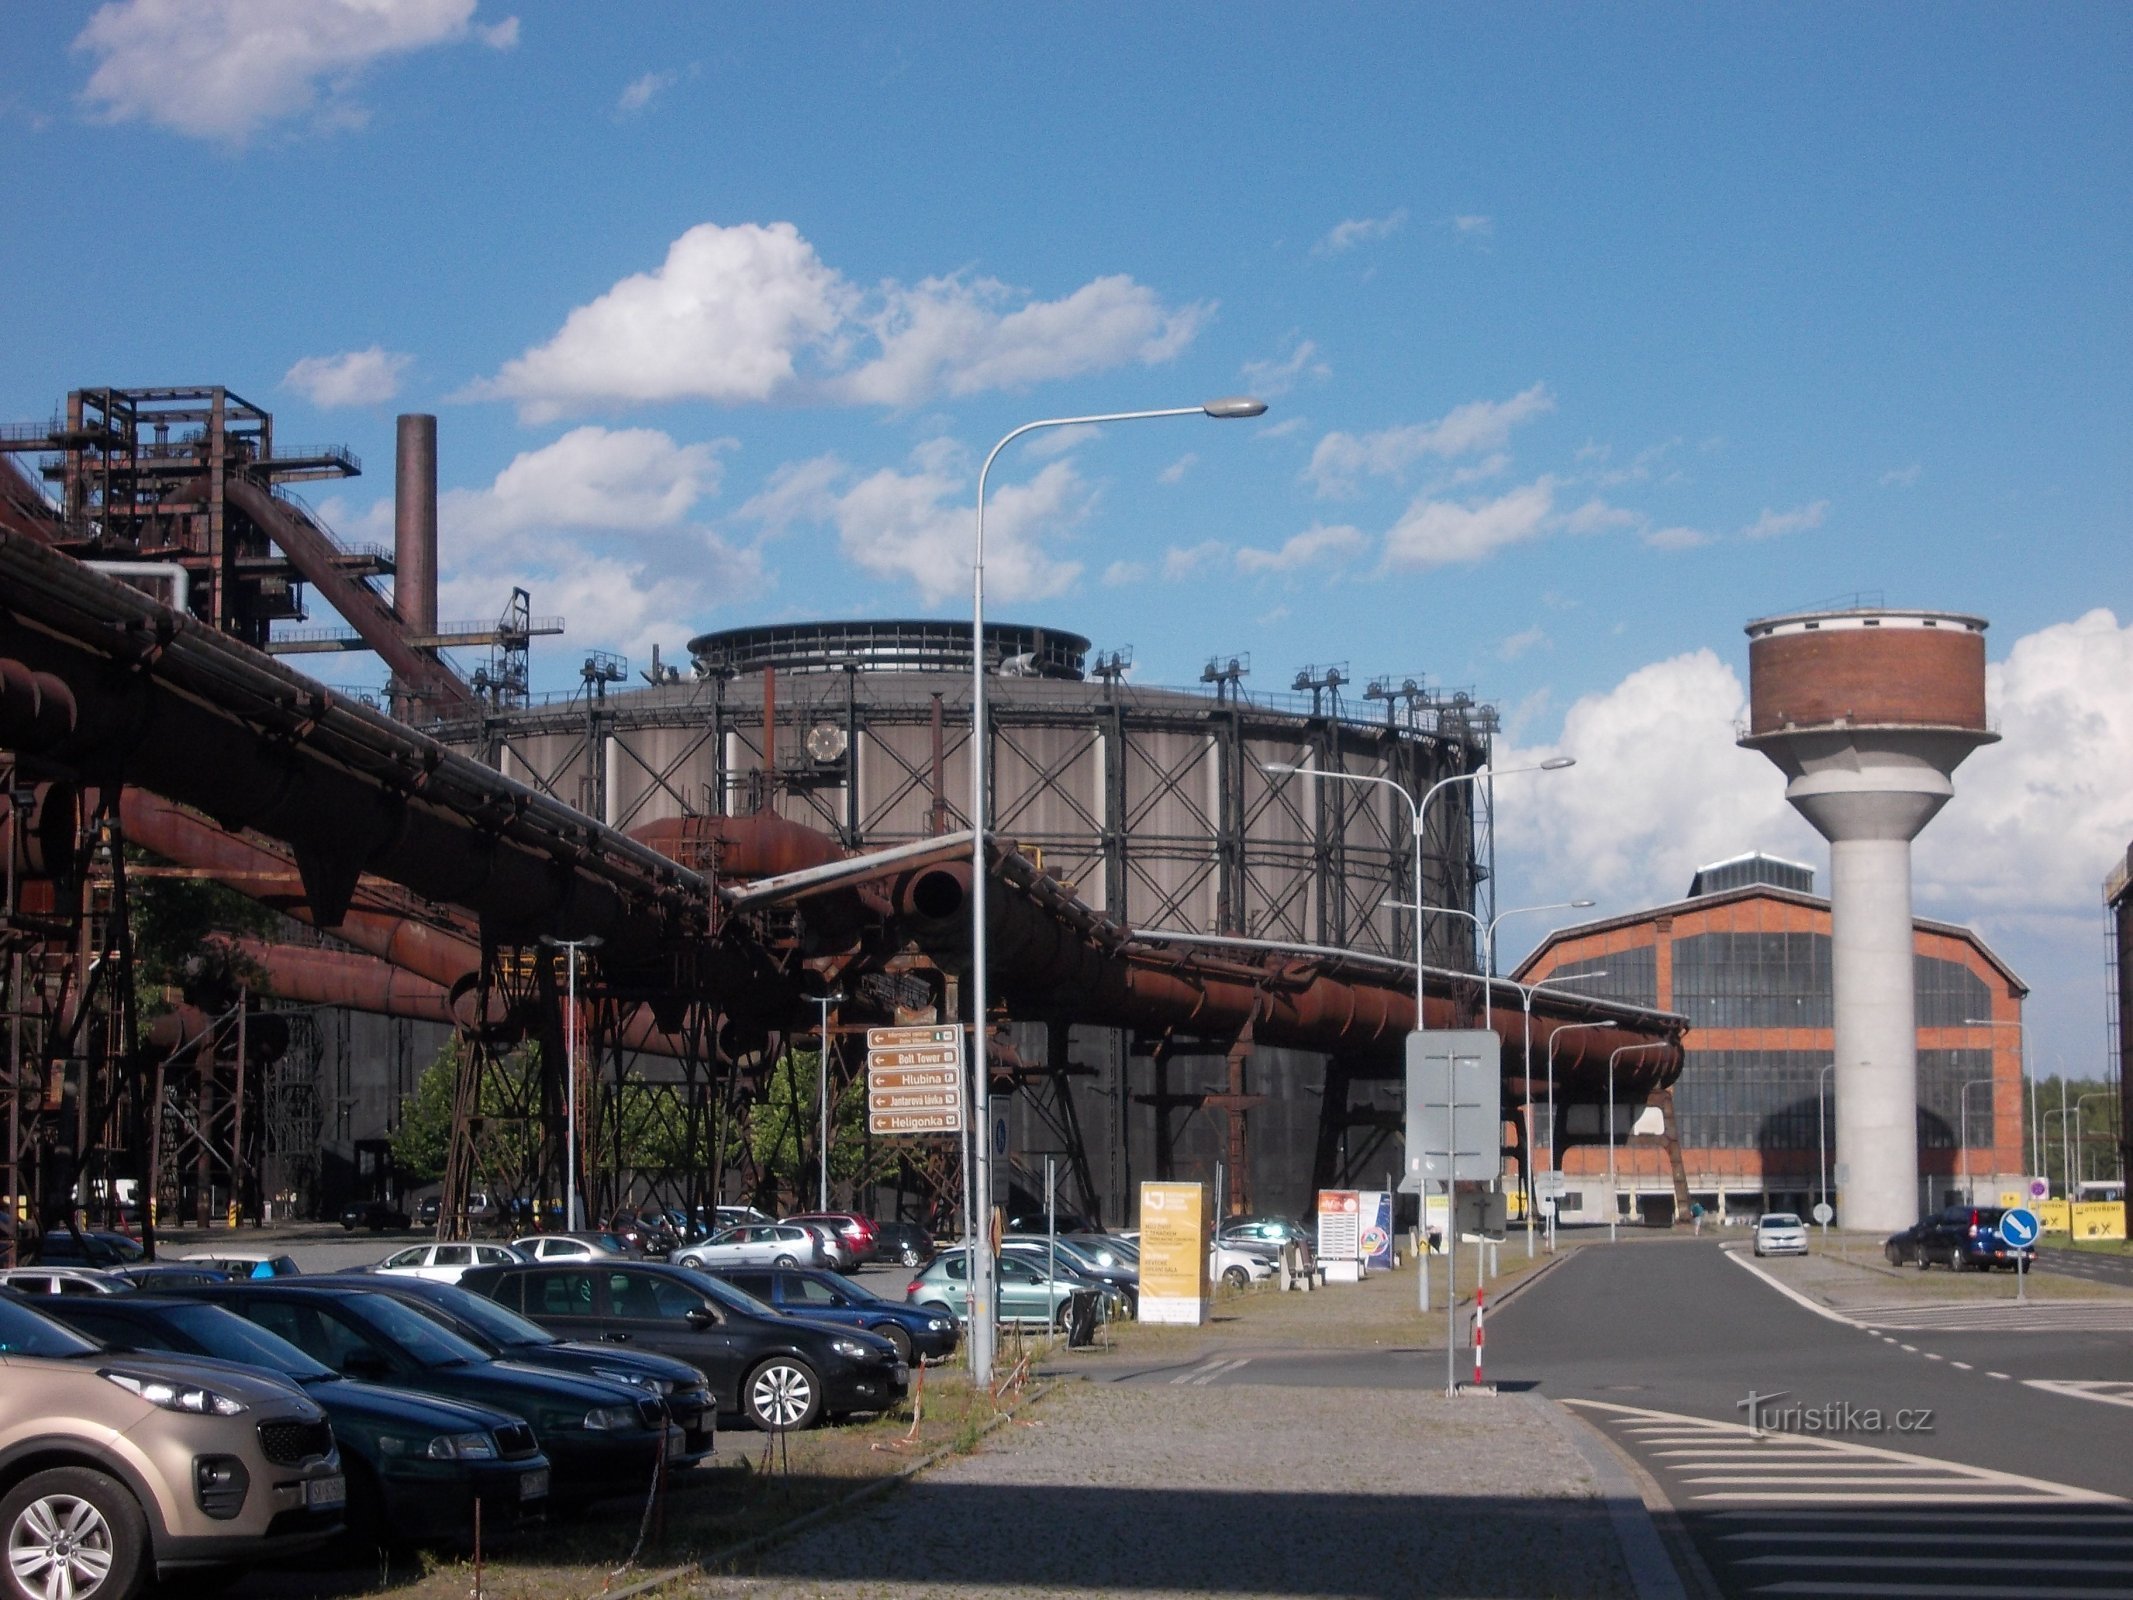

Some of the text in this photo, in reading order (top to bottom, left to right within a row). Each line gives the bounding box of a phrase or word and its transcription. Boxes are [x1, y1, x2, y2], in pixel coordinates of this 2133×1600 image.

[898, 1052, 941, 1064] Bolt Tower
[902, 1073, 942, 1085] Hlubina
[891, 1115, 943, 1129] Heligonka
